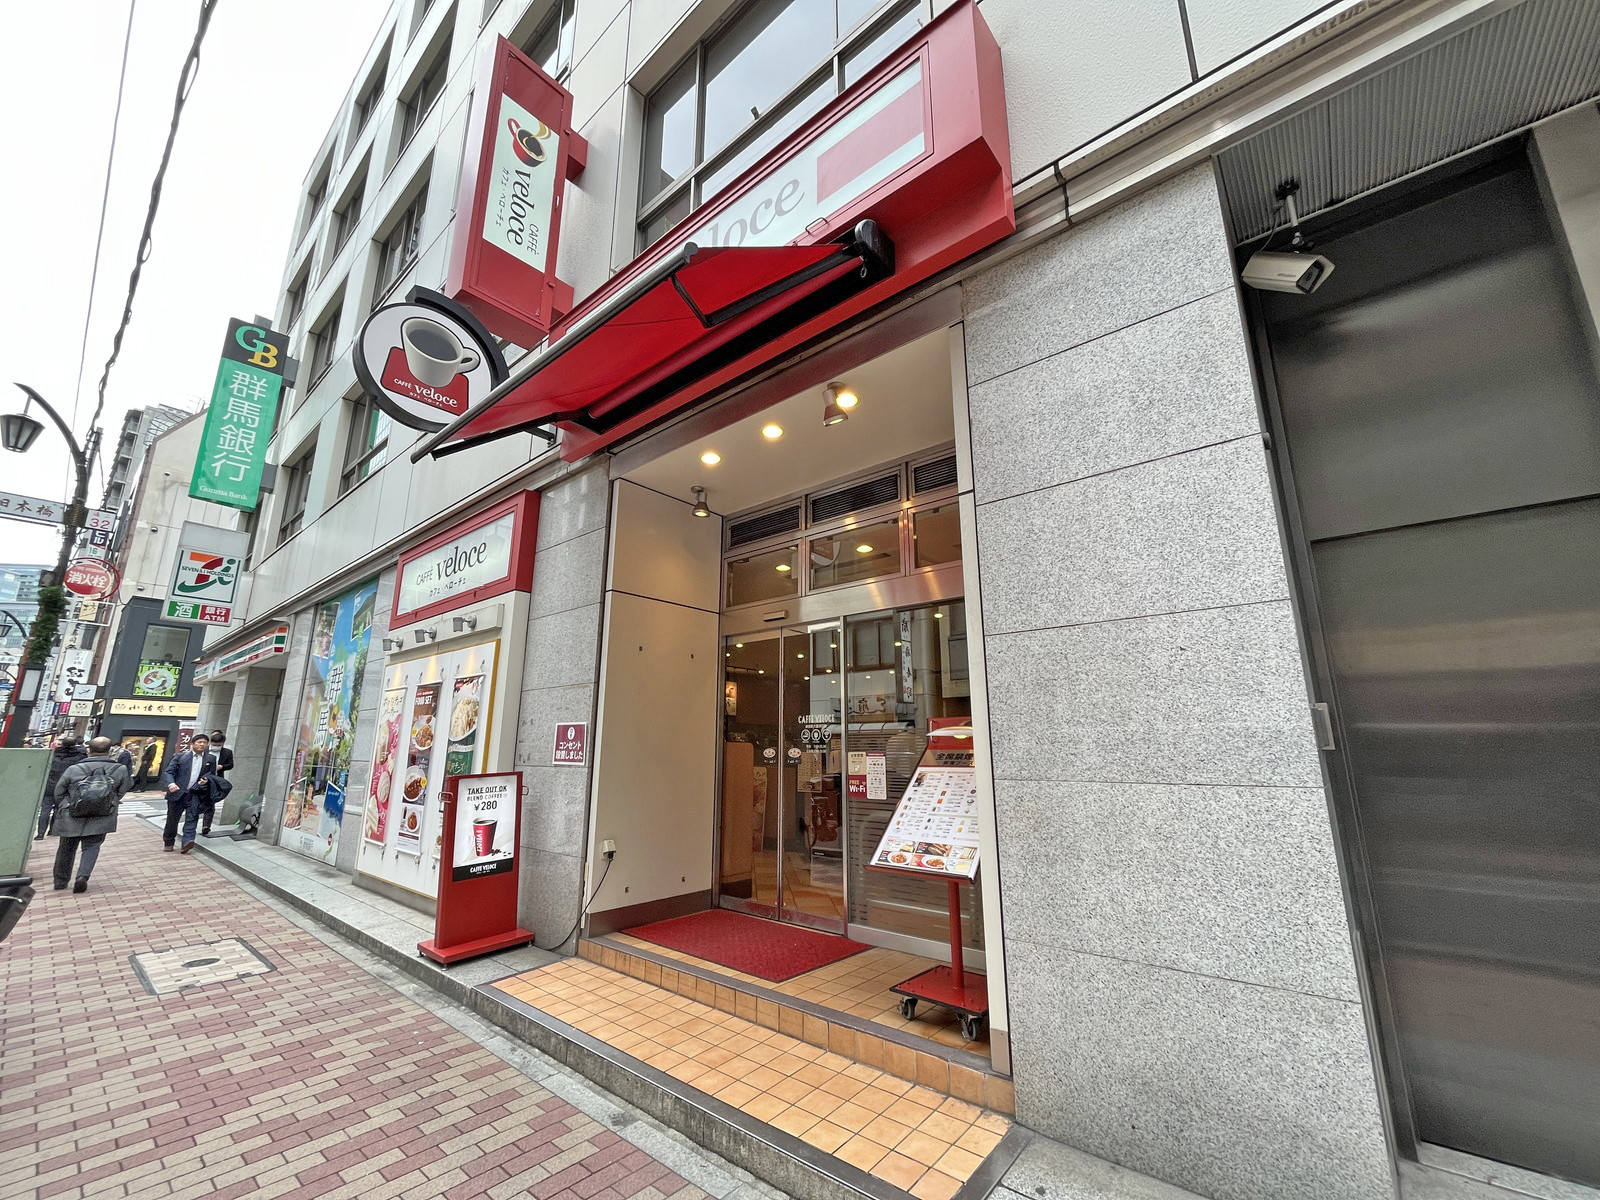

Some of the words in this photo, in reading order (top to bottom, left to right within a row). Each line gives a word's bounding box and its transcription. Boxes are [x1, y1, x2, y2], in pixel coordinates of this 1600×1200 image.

[507, 169, 535, 246] veloce
[707, 179, 805, 247] loce
[414, 384, 458, 407] veloce
[211, 370, 268, 482] 群馬銀行
[199, 485, 228, 496] Gunma
[228, 490, 248, 501] Bank
[0, 498, 54, 517] 日本橋
[89, 518, 110, 530] 32
[436, 542, 488, 581] veloce
[66, 570, 108, 588] 消火栓
[173, 602, 195, 617] 酒
[139, 665, 181, 675] TOYO
[558, 740, 582, 750] コンセント
[467, 787, 484, 796] TAKE
[485, 786, 497, 794] OUT
[484, 792, 503, 800] COFFEE
[473, 800, 498, 811] ¥280
